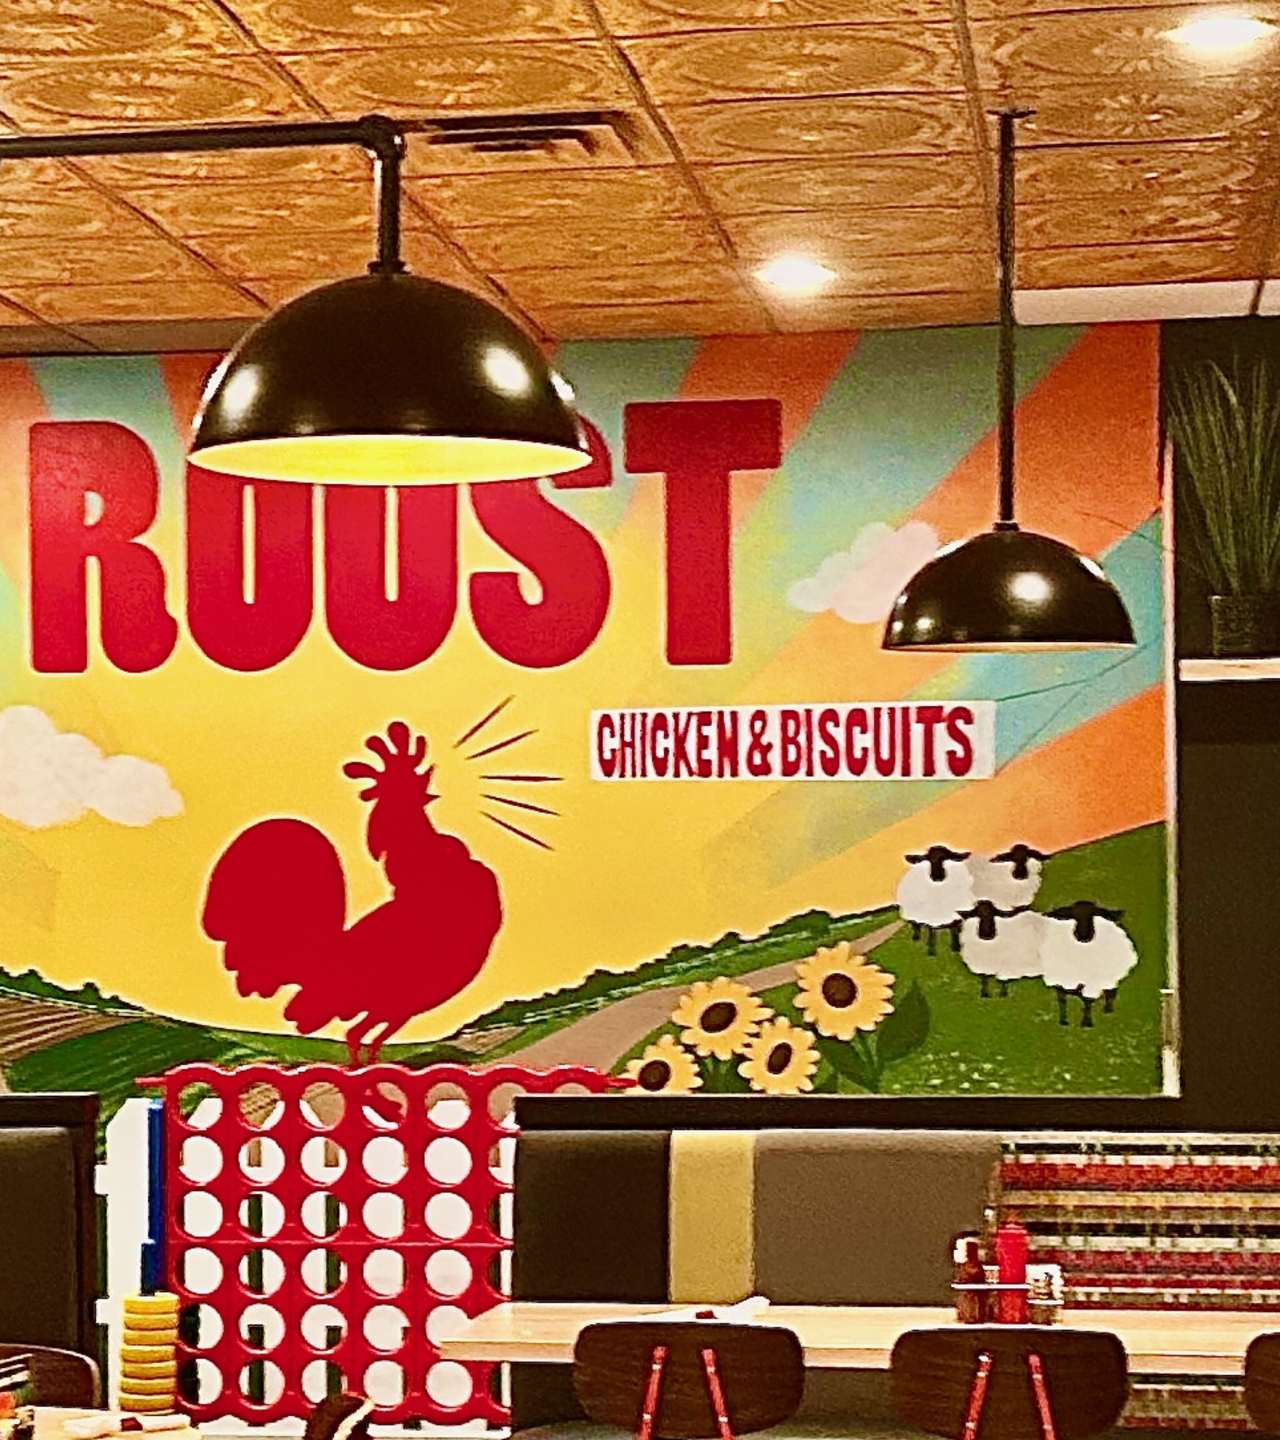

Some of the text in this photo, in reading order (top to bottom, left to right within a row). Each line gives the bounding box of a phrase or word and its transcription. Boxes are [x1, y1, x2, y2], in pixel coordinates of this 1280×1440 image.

[29, 399, 782, 673] ROOST
[597, 705, 974, 778] CHICKEN & BISCUITS
